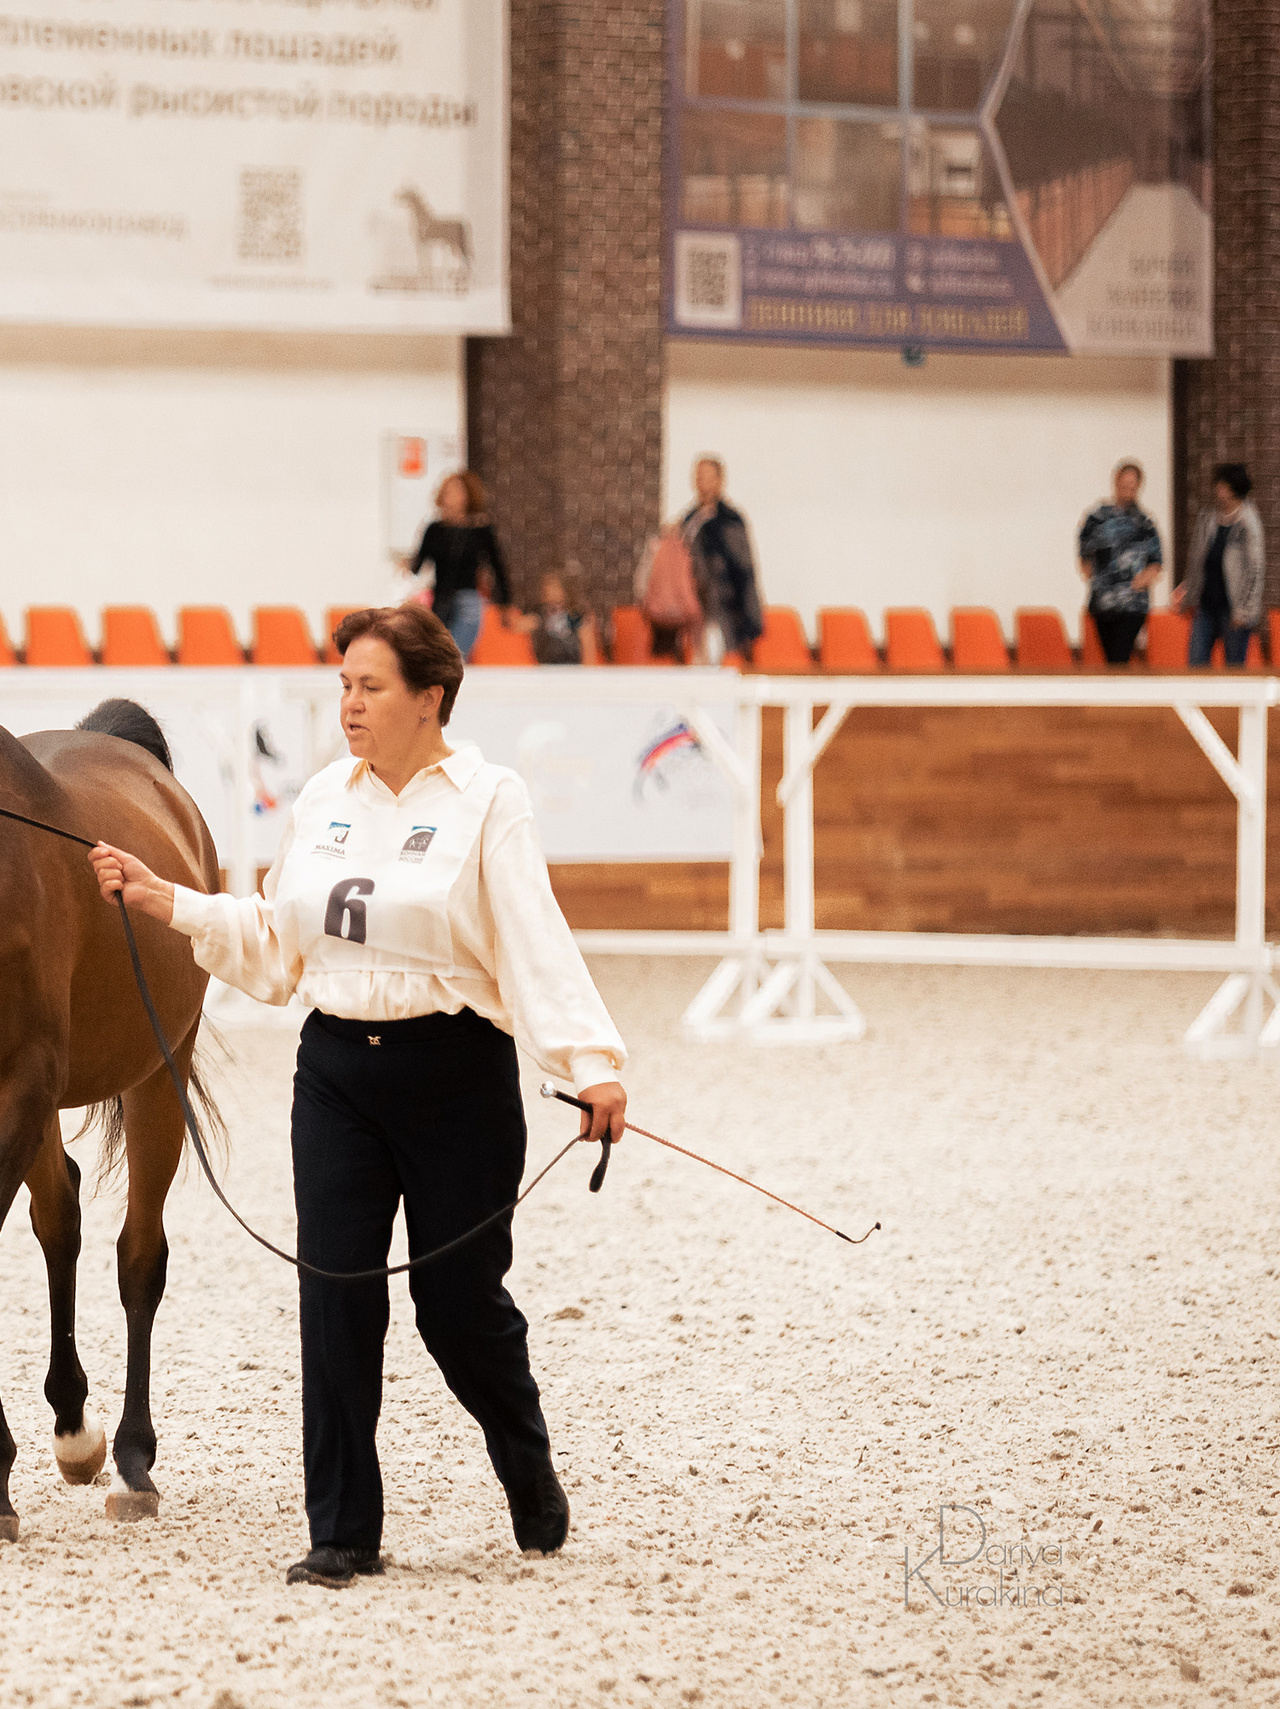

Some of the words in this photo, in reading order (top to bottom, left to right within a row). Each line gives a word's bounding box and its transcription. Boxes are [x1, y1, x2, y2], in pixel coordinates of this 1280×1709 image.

[227, 25, 401, 68] лошадей
[127, 79, 319, 126] рысистой
[326, 90, 479, 131] породы
[314, 844, 346, 855] MAXIMA
[324, 877, 375, 945] 6
